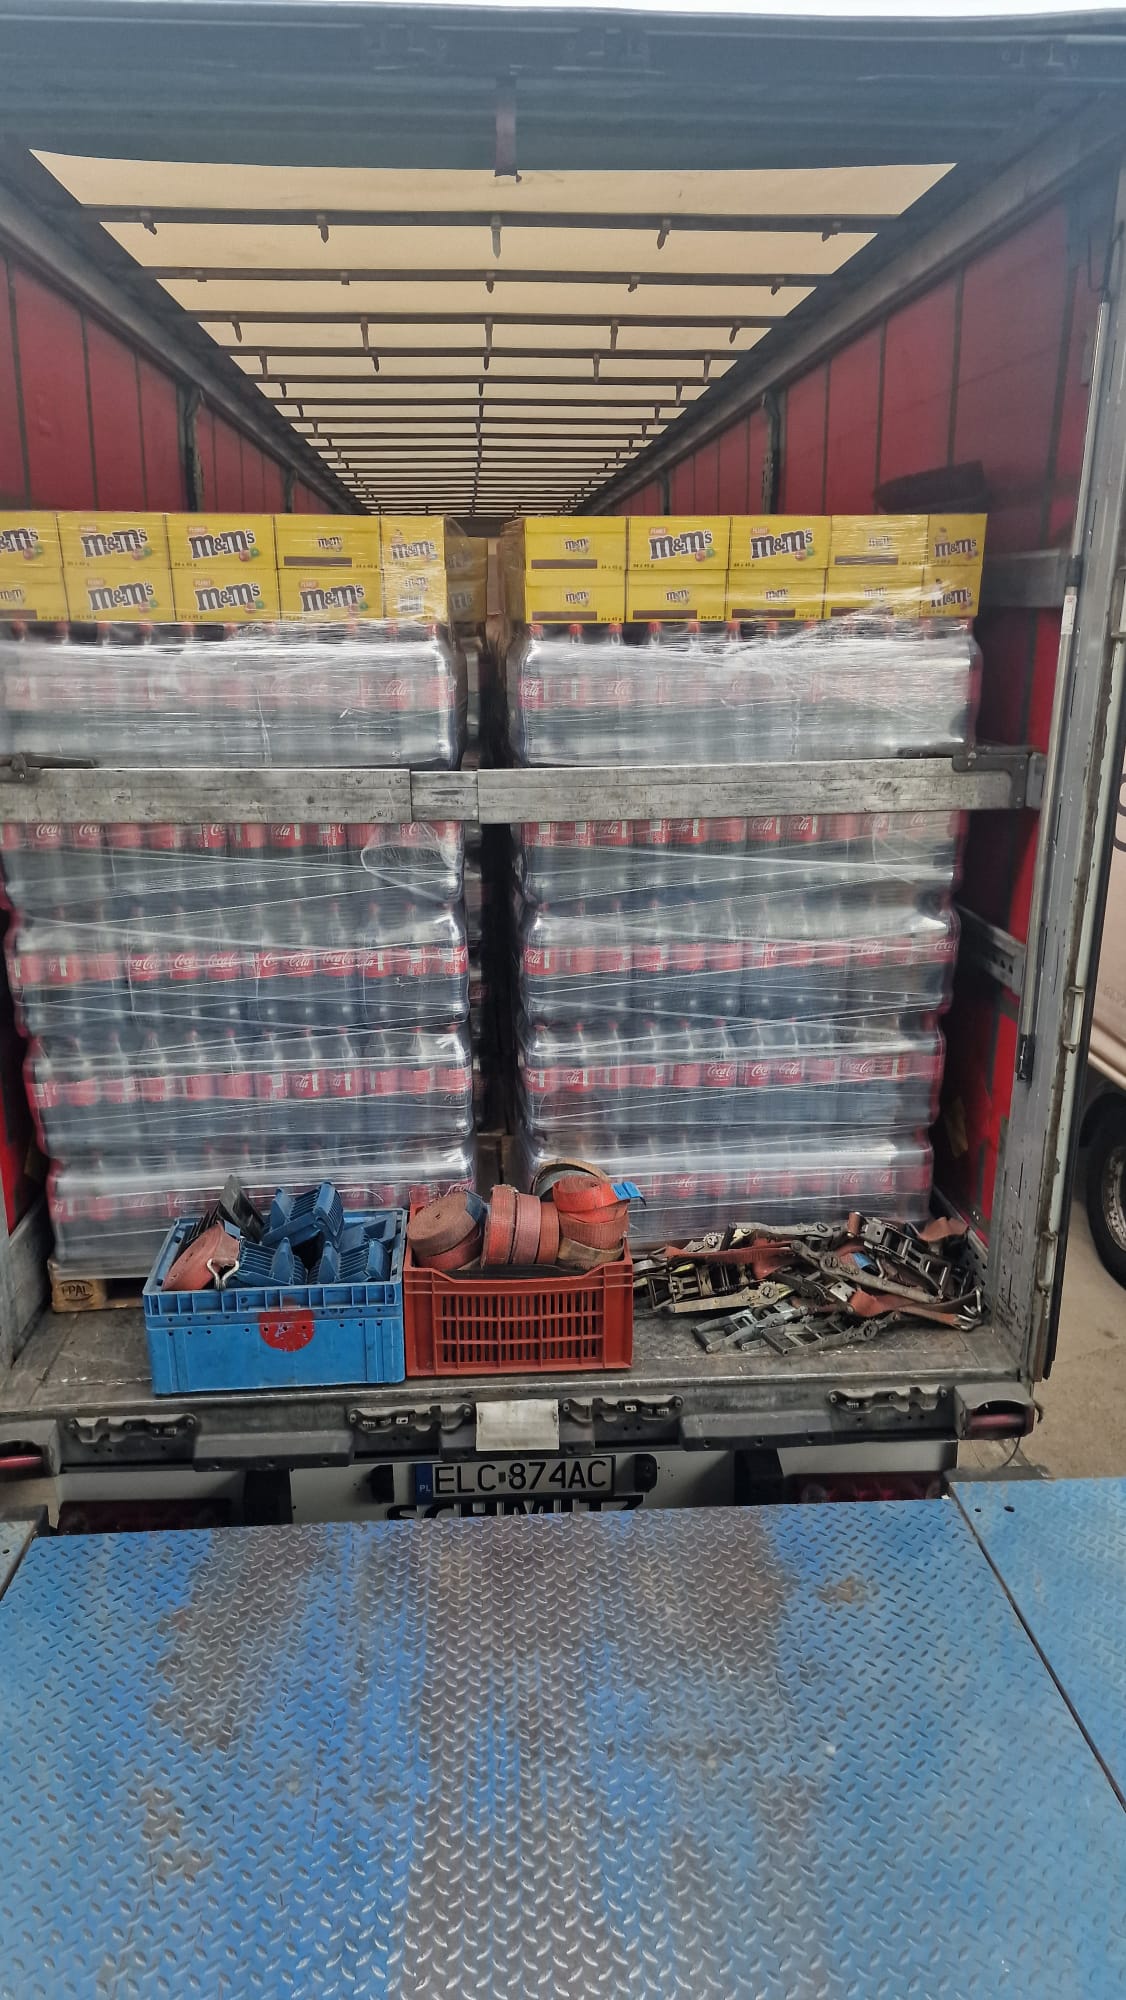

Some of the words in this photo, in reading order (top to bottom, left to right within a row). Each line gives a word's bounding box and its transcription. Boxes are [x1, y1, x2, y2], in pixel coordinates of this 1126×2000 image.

[434, 1464, 497, 1494] ELC
[508, 1460, 607, 1490] 874AC
[419, 1484, 431, 1492] PL
